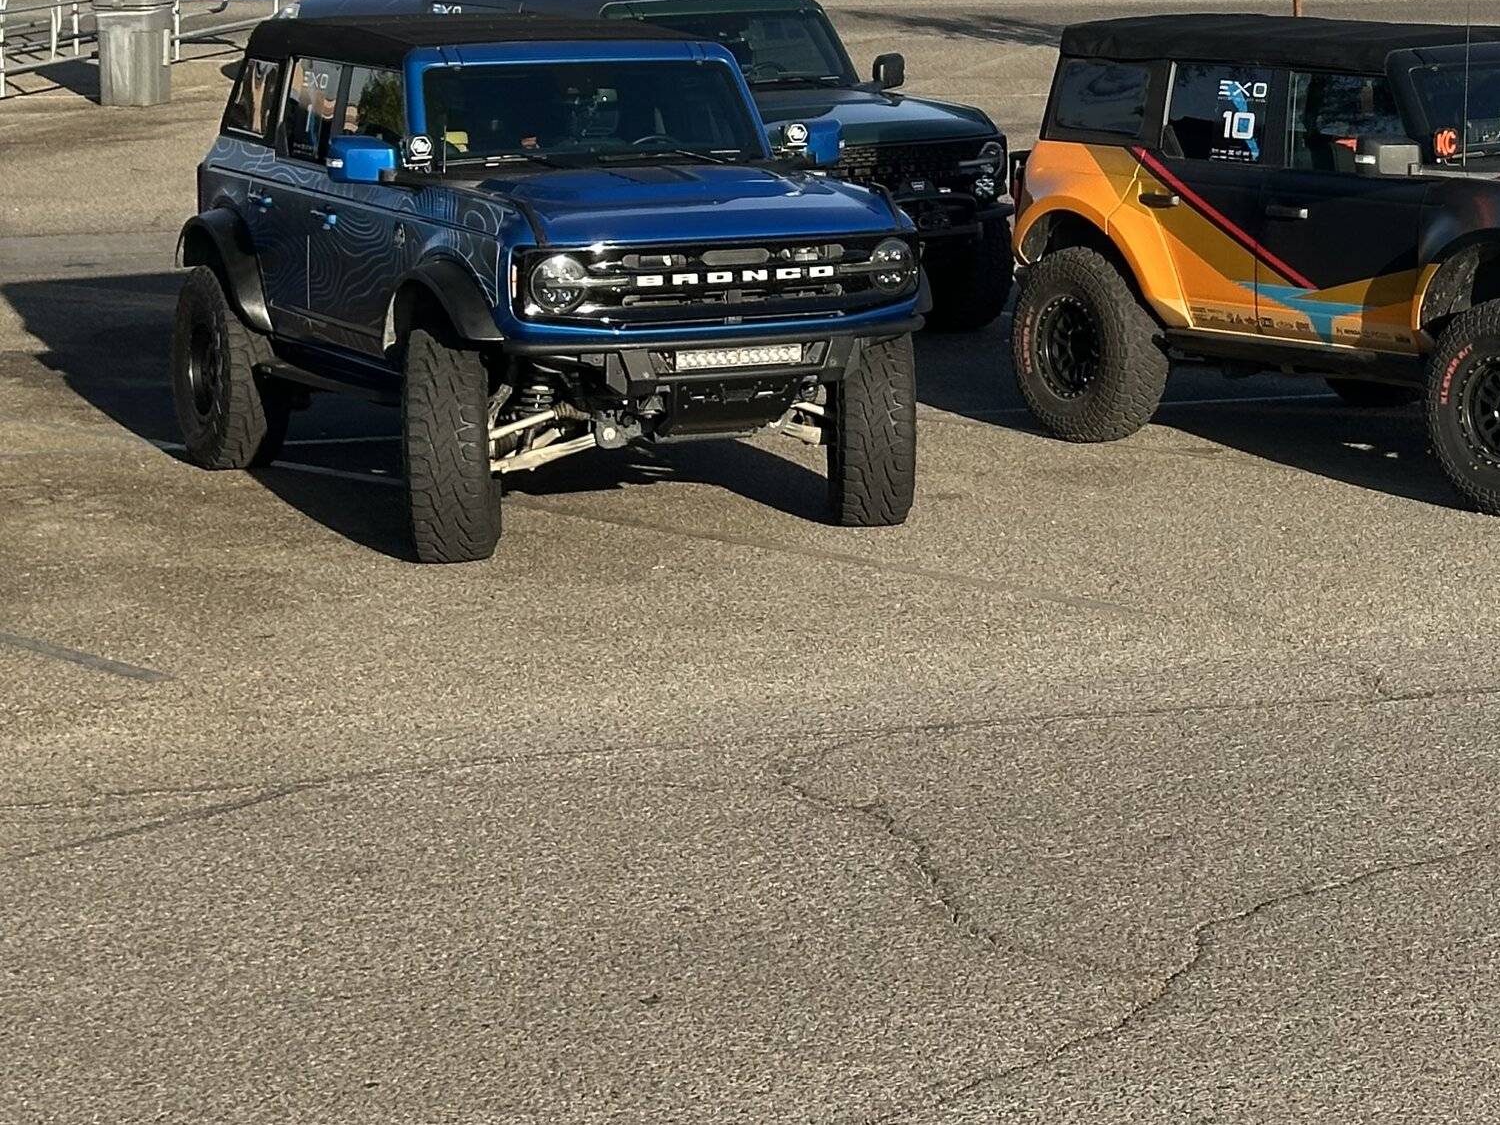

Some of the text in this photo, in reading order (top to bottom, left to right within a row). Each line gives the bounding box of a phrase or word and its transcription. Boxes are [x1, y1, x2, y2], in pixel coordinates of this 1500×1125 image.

[303, 70, 329, 90] EXO
[1218, 79, 1268, 98] EXO
[1222, 110, 1256, 140] 10
[1435, 129, 1457, 156] KC
[636, 265, 835, 287] BRONCO
[1440, 357, 1460, 405] KLEVER
